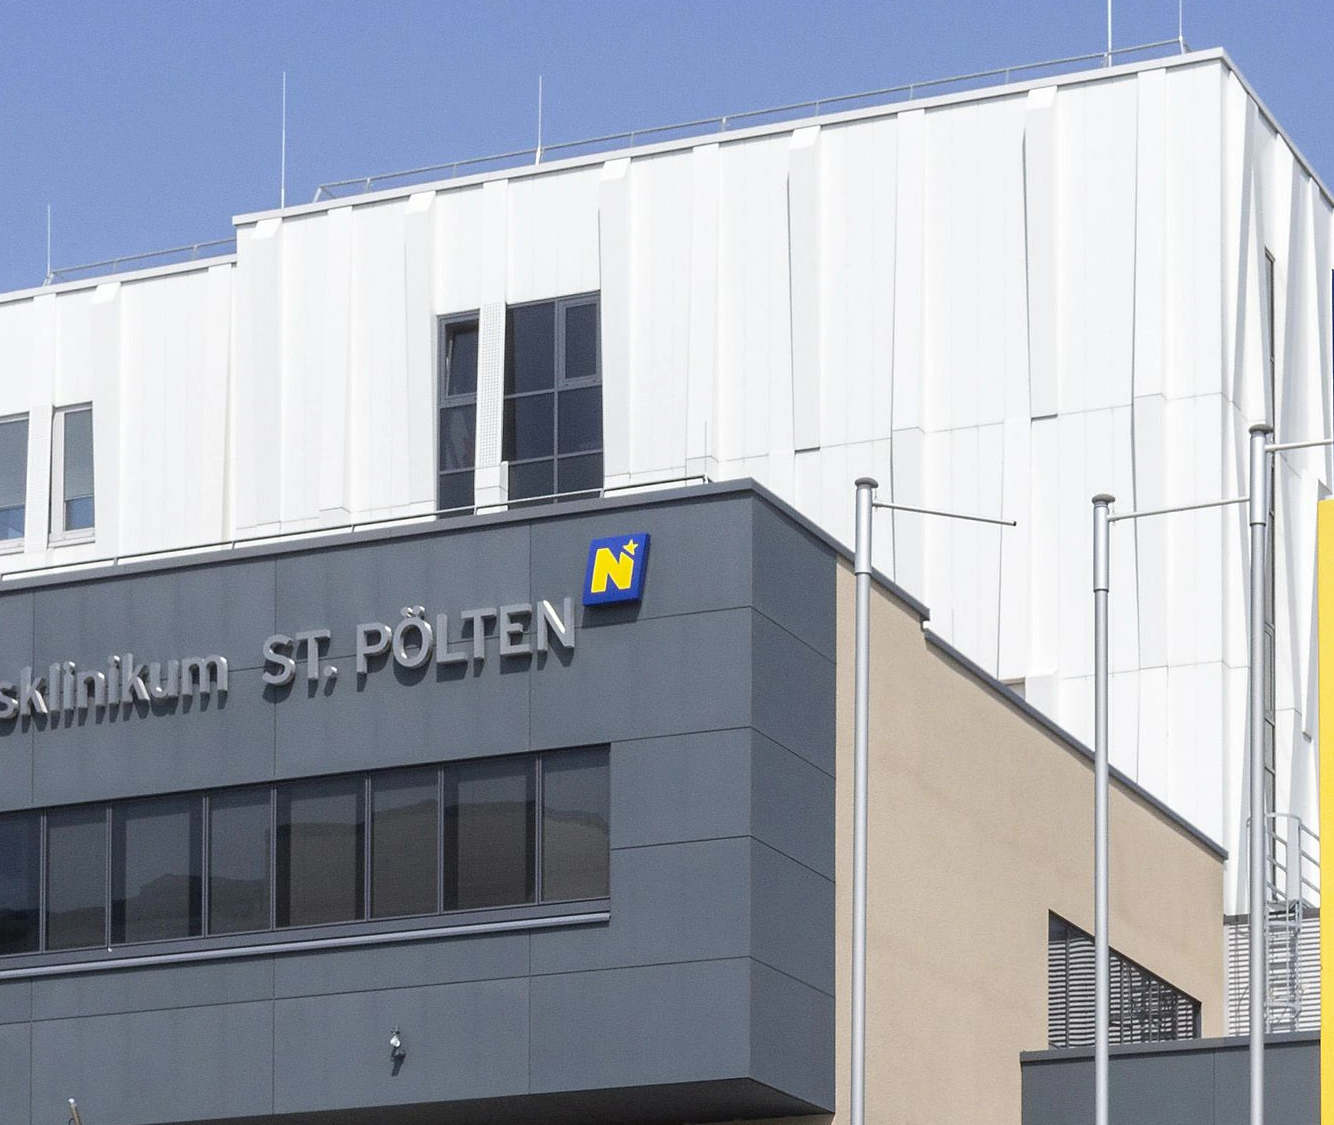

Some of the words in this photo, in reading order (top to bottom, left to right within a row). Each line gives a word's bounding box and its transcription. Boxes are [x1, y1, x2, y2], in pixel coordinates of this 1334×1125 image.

[591, 547, 634, 593] N
[262, 629, 338, 686] ST.
[356, 597, 574, 674] PÖLTEN
